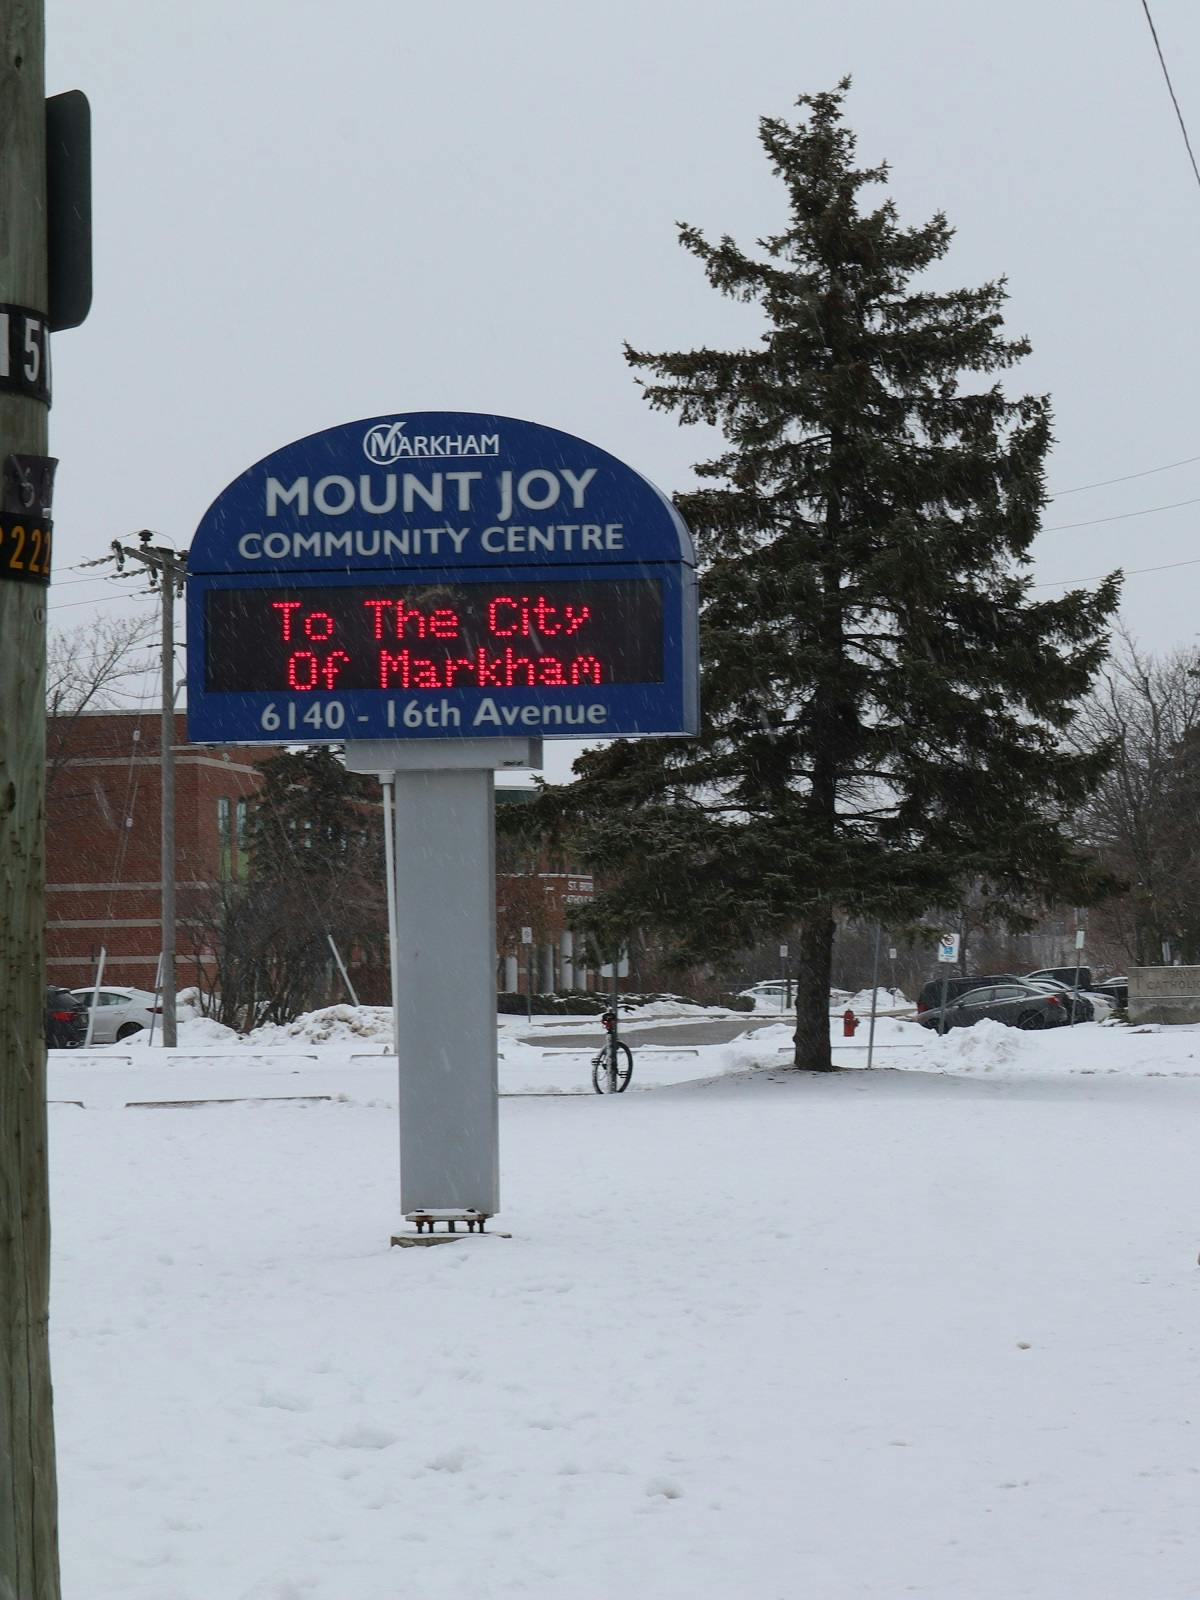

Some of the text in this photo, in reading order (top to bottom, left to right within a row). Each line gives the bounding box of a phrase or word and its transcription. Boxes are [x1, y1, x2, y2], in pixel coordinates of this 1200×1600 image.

[363, 421, 499, 465] MARKHAM
[265, 468, 598, 521] MOUNT JOY
[238, 523, 624, 560] COMMUNITY CENTRE
[272, 596, 591, 641] To The City
[287, 648, 602, 691] Of Markham
[261, 700, 346, 731] 6140
[387, 698, 461, 728] 16th
[473, 697, 608, 727] Avenue
